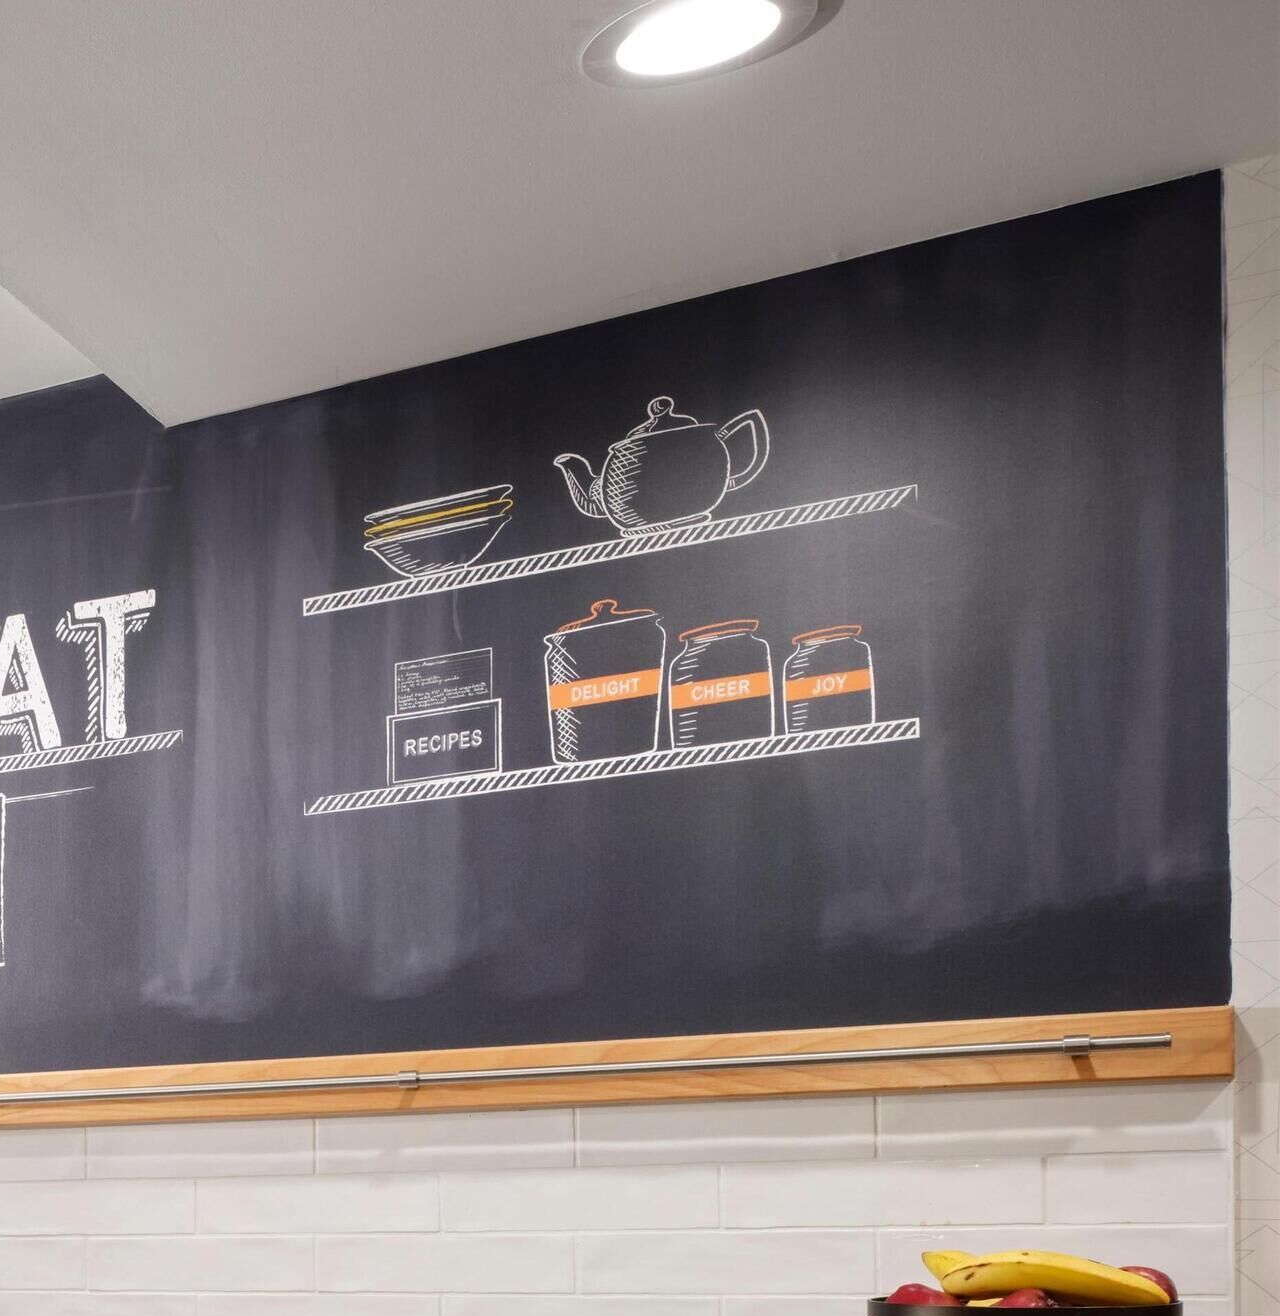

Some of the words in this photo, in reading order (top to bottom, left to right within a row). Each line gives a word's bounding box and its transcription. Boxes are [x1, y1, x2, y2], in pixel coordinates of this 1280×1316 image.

[571, 678, 641, 702] DELIGHT
[691, 679, 751, 701] CHEER
[812, 675, 848, 695] JOY
[404, 729, 483, 758] RECIPES
